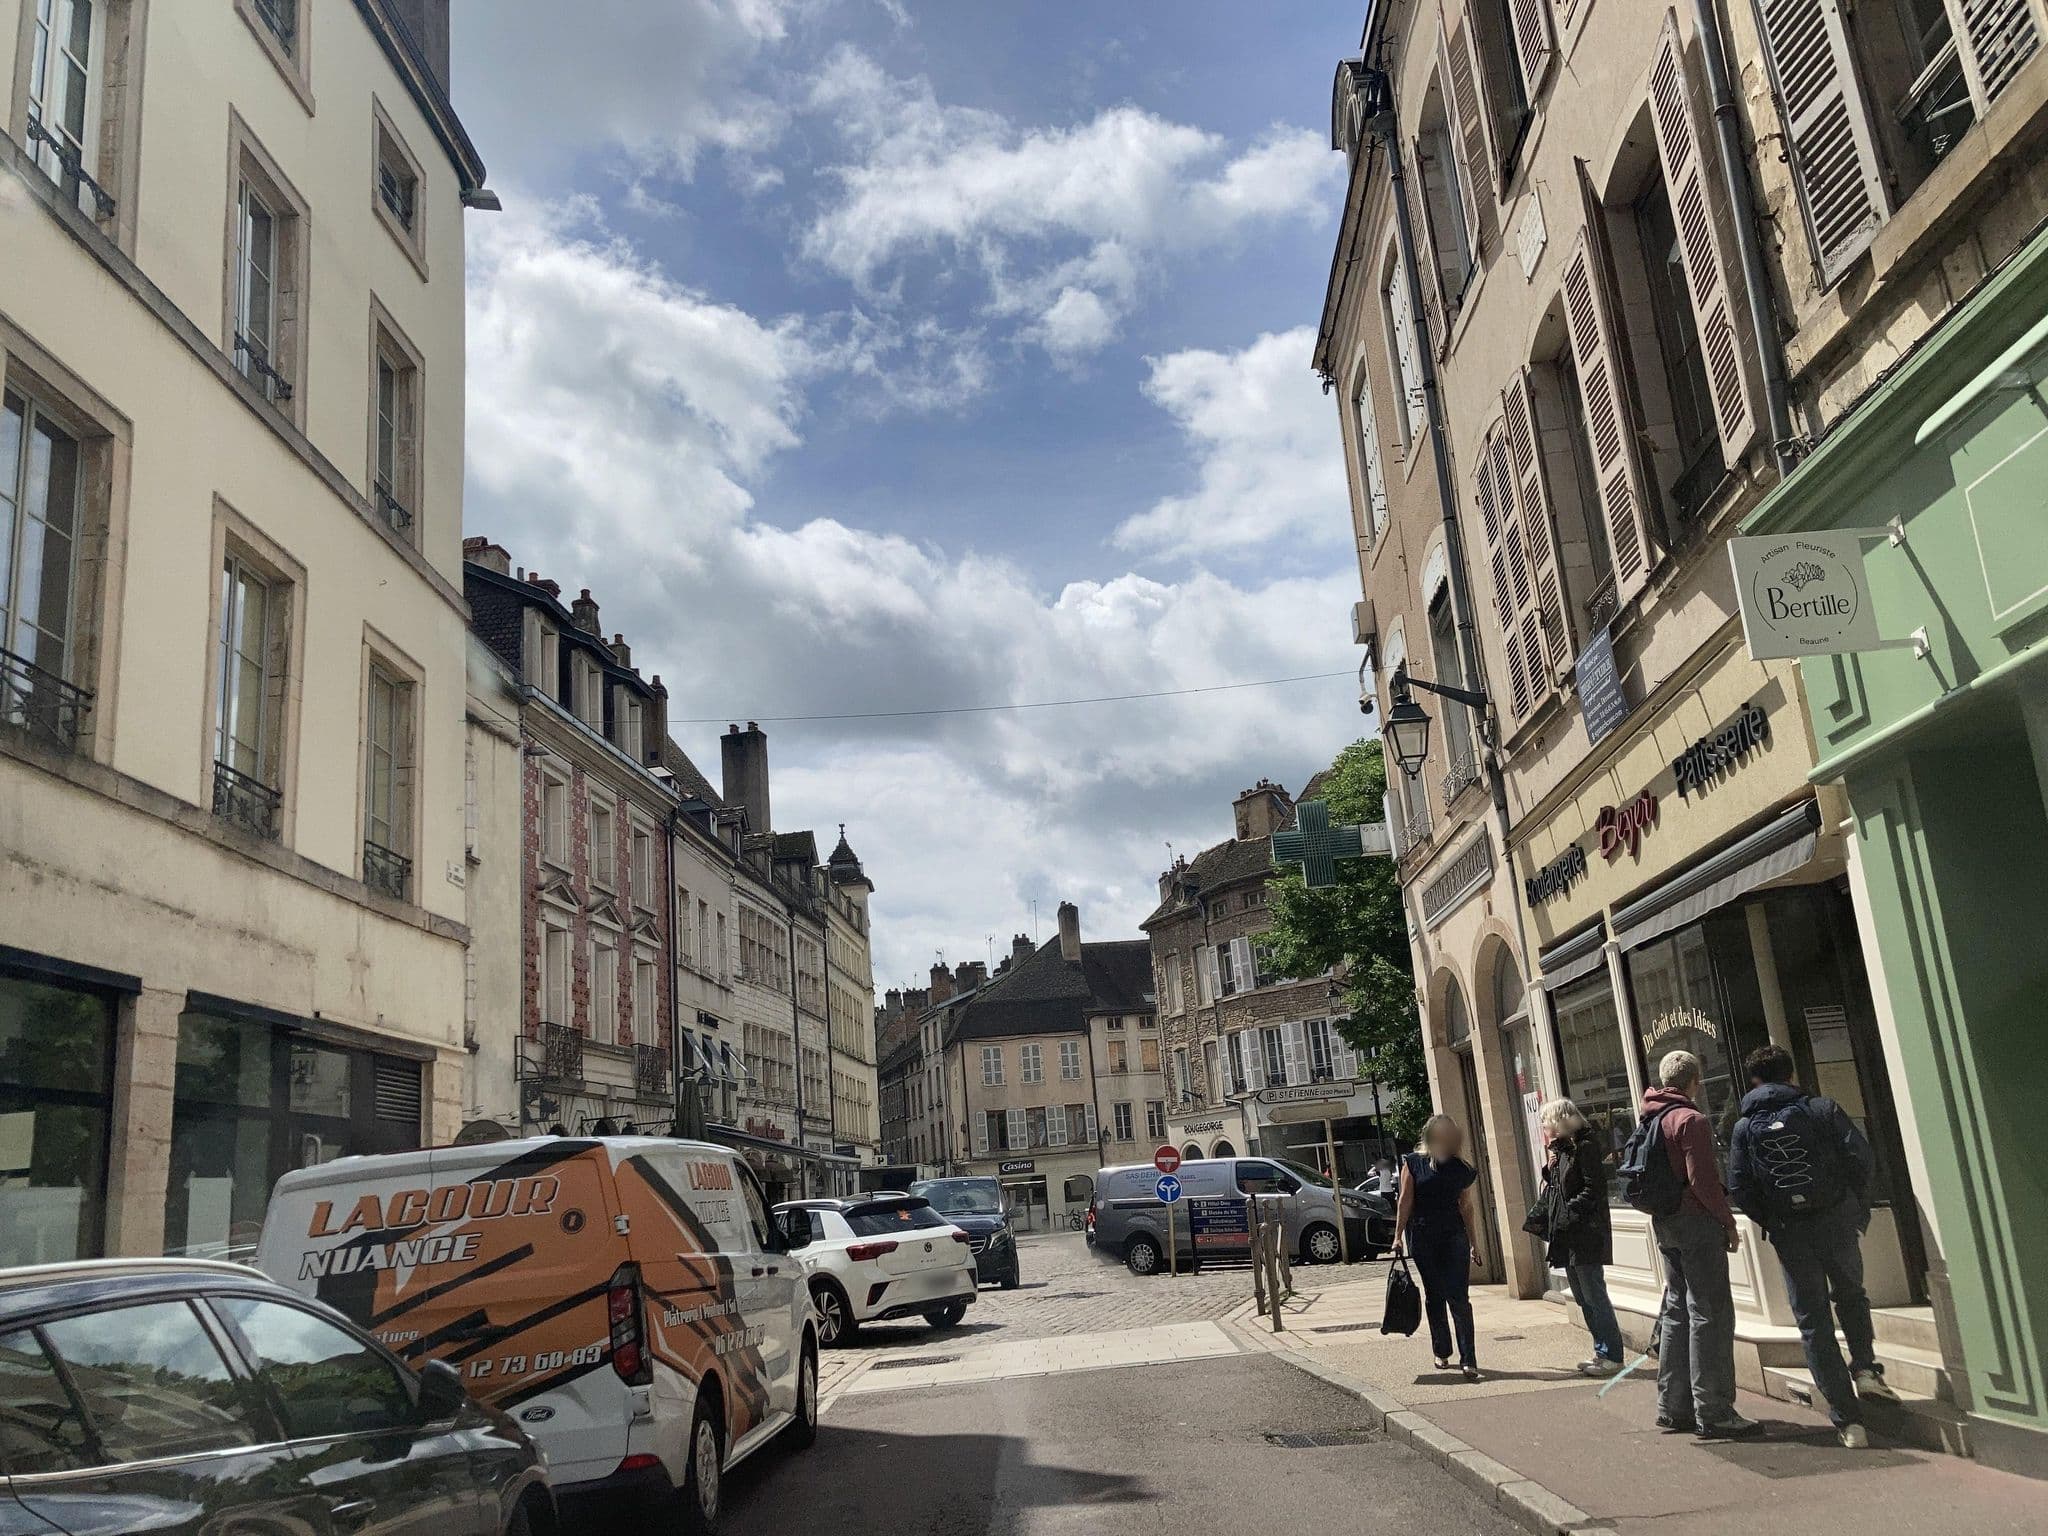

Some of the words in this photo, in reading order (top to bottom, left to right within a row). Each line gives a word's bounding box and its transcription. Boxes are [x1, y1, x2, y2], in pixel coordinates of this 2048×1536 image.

[1760, 545, 1790, 564] Artisan
[1796, 542, 1836, 559] Fleuriste
[1767, 587, 1850, 620] Bertille
[1799, 636, 1829, 645] Beaune
[1525, 843, 1586, 908] Boulangerie
[1595, 790, 1658, 860] Beyer
[1672, 703, 1767, 798] Pâtisserie
[1643, 1032, 1655, 1055] Du
[1652, 1012, 1671, 1040] Goût
[1670, 1008, 1678, 1028] et
[1678, 1006, 1692, 1027] des
[1692, 1007, 1717, 1039] Idées
[1288, 1088, 1320, 1098] ETIENNE
[1184, 1120, 1224, 1134] ROUGEGORGE
[1002, 1162, 1032, 1171] Casino
[307, 1176, 560, 1238] LACOUR
[299, 1233, 482, 1280] NUANCE
[470, 1359, 493, 1378] 12
[500, 1356, 527, 1375] 73
[571, 1345, 602, 1366] 83
